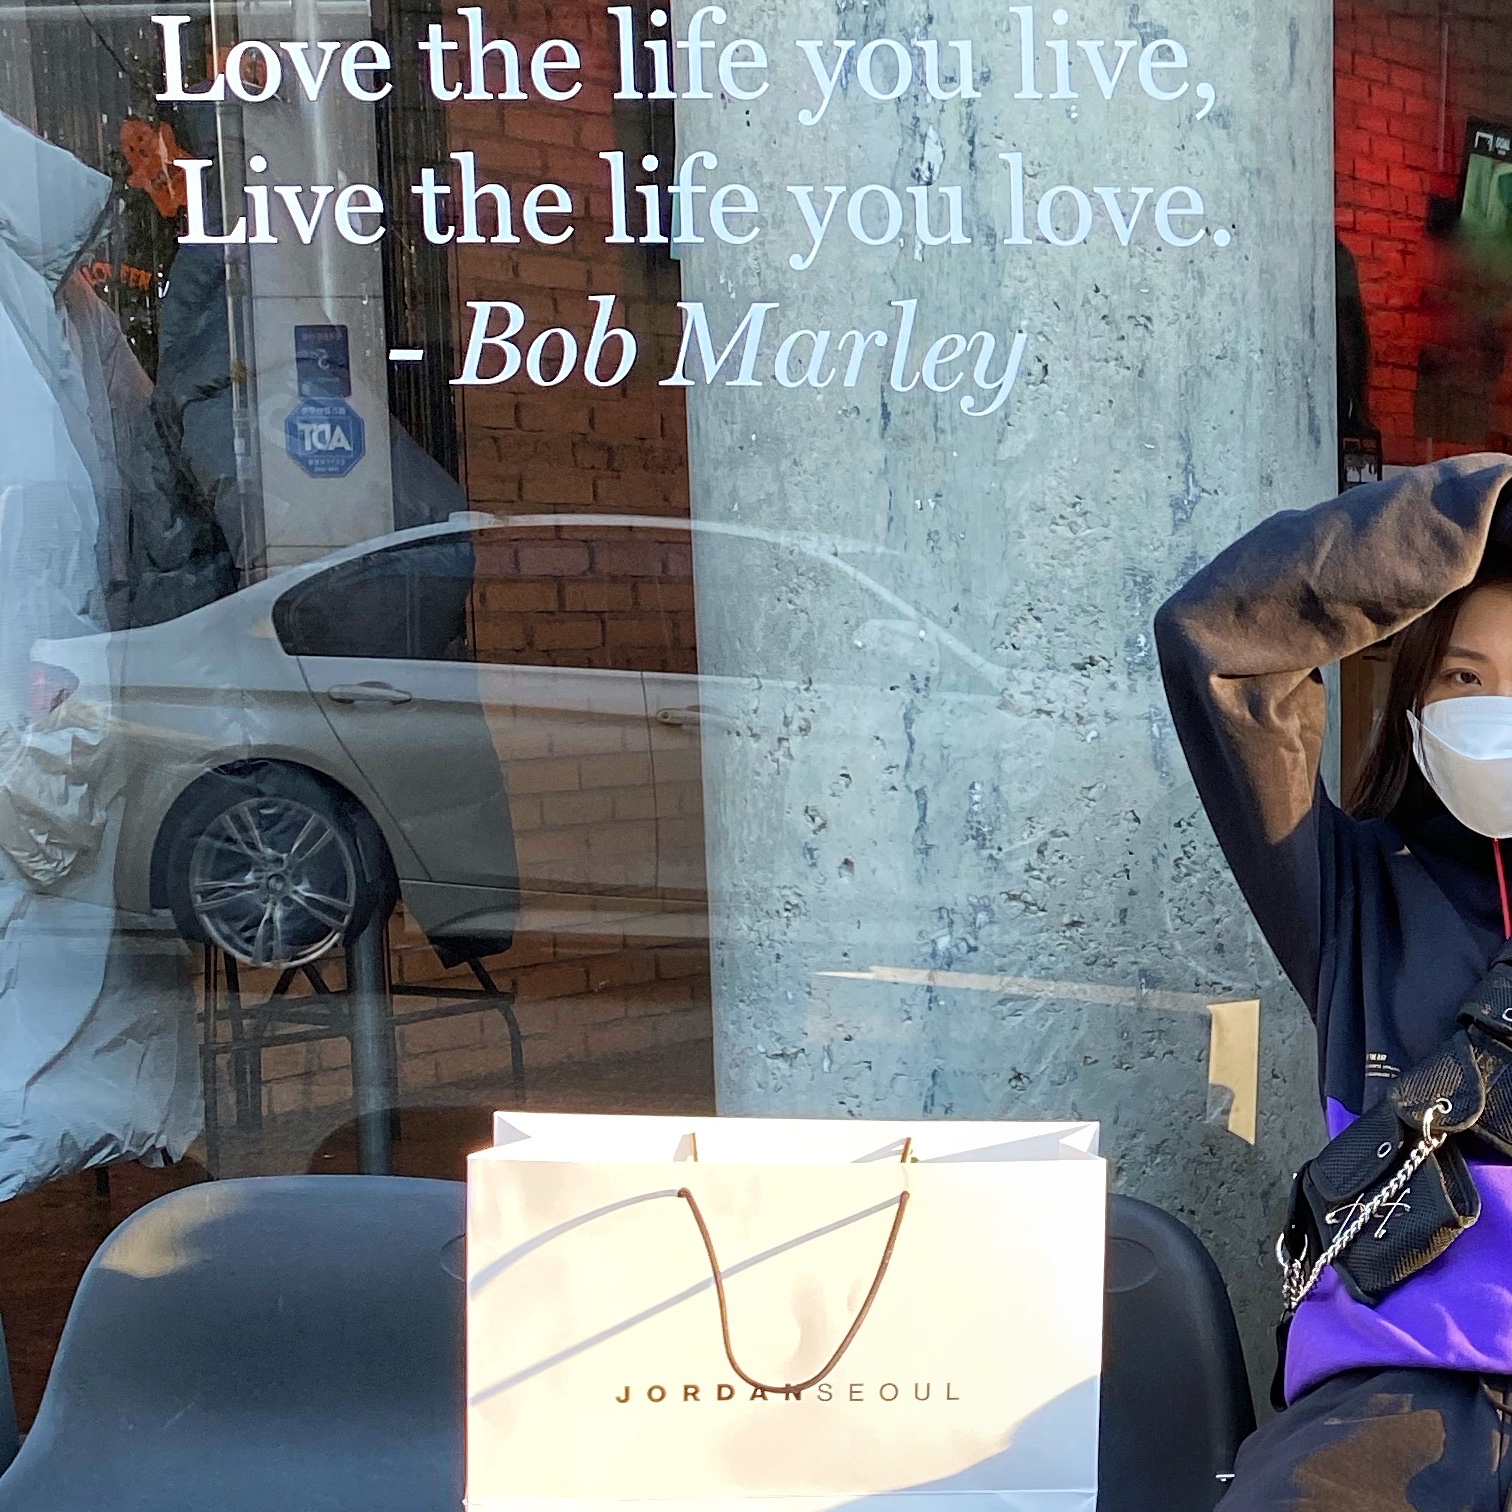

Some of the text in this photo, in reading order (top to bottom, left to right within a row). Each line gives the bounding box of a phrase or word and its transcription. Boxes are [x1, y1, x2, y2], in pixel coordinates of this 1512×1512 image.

[152, 5, 1217, 127] Love the life you live,
[173, 151, 1231, 271] Live the life you love.
[450, 294, 637, 389] Bob
[659, 298, 1028, 417] Marley
